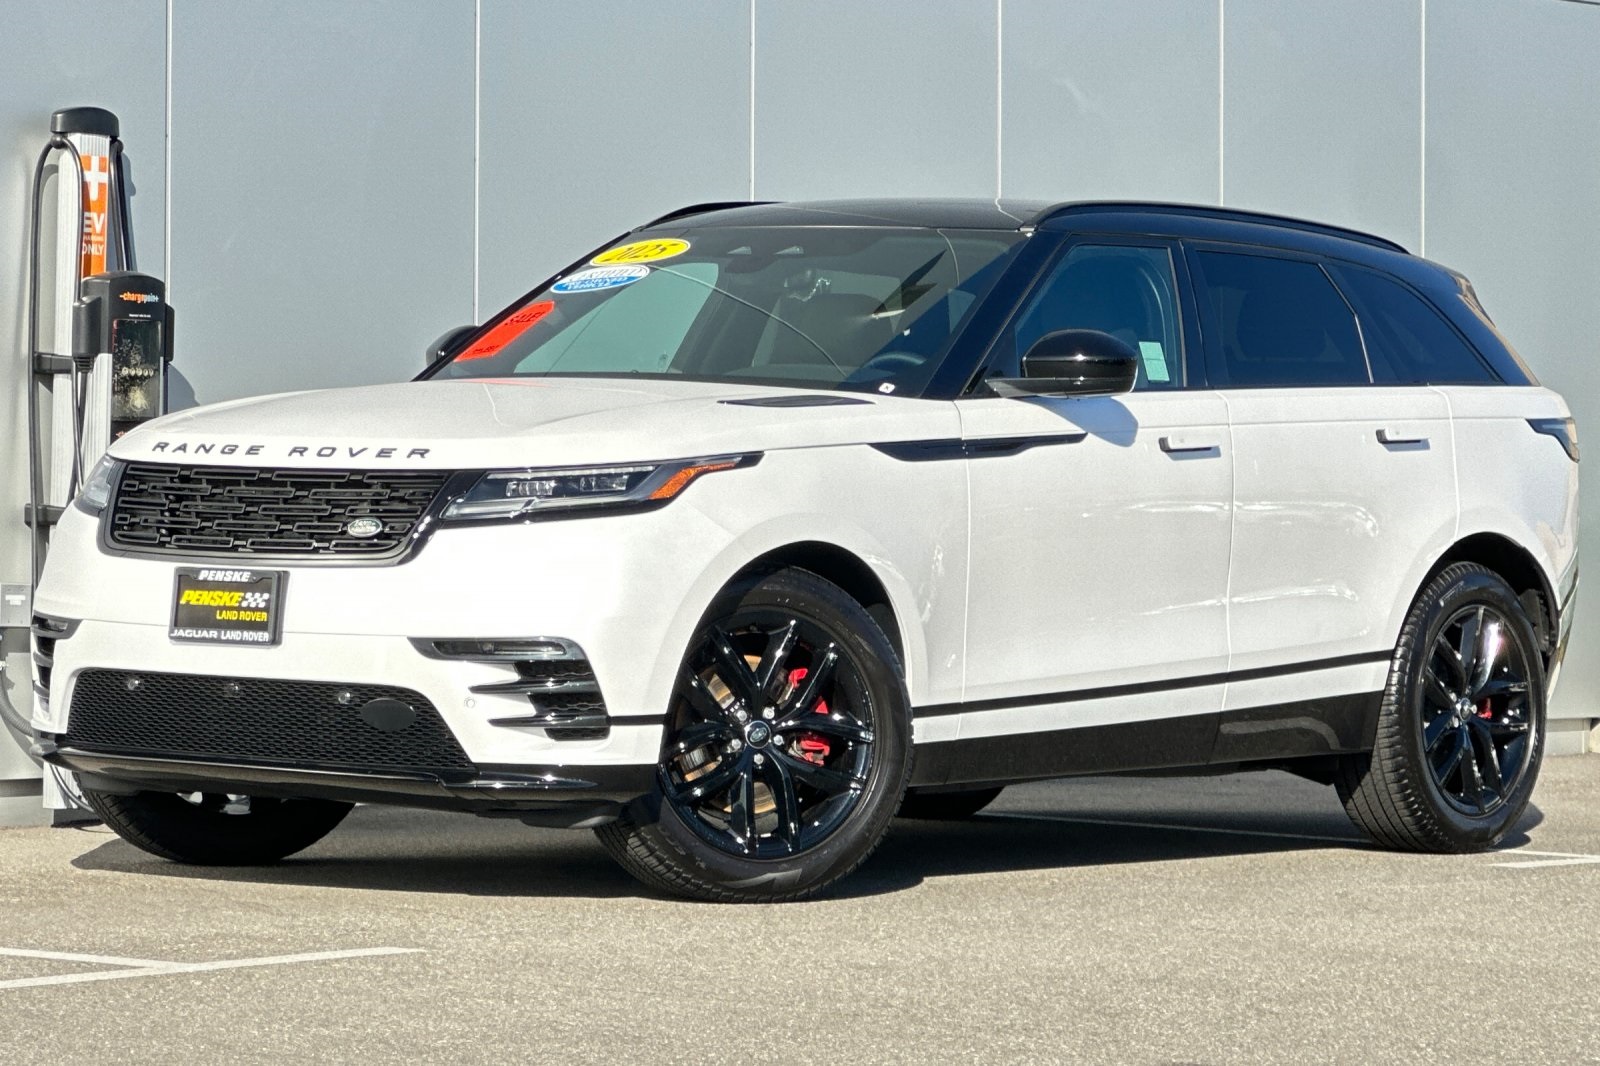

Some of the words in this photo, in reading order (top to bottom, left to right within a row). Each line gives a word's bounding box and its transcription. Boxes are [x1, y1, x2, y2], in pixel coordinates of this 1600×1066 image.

[84, 212, 104, 234] EV
[82, 243, 104, 254] ONLY
[152, 442, 264, 456] RANGE
[288, 446, 431, 459] ROVER
[198, 570, 252, 582] PENSKE
[180, 590, 243, 606] PENSKE
[216, 610, 238, 620] LAND
[239, 611, 268, 622] ROVER
[170, 630, 218, 638] JAGUAR
[221, 630, 241, 641] LAND
[242, 632, 270, 642] ROVER
